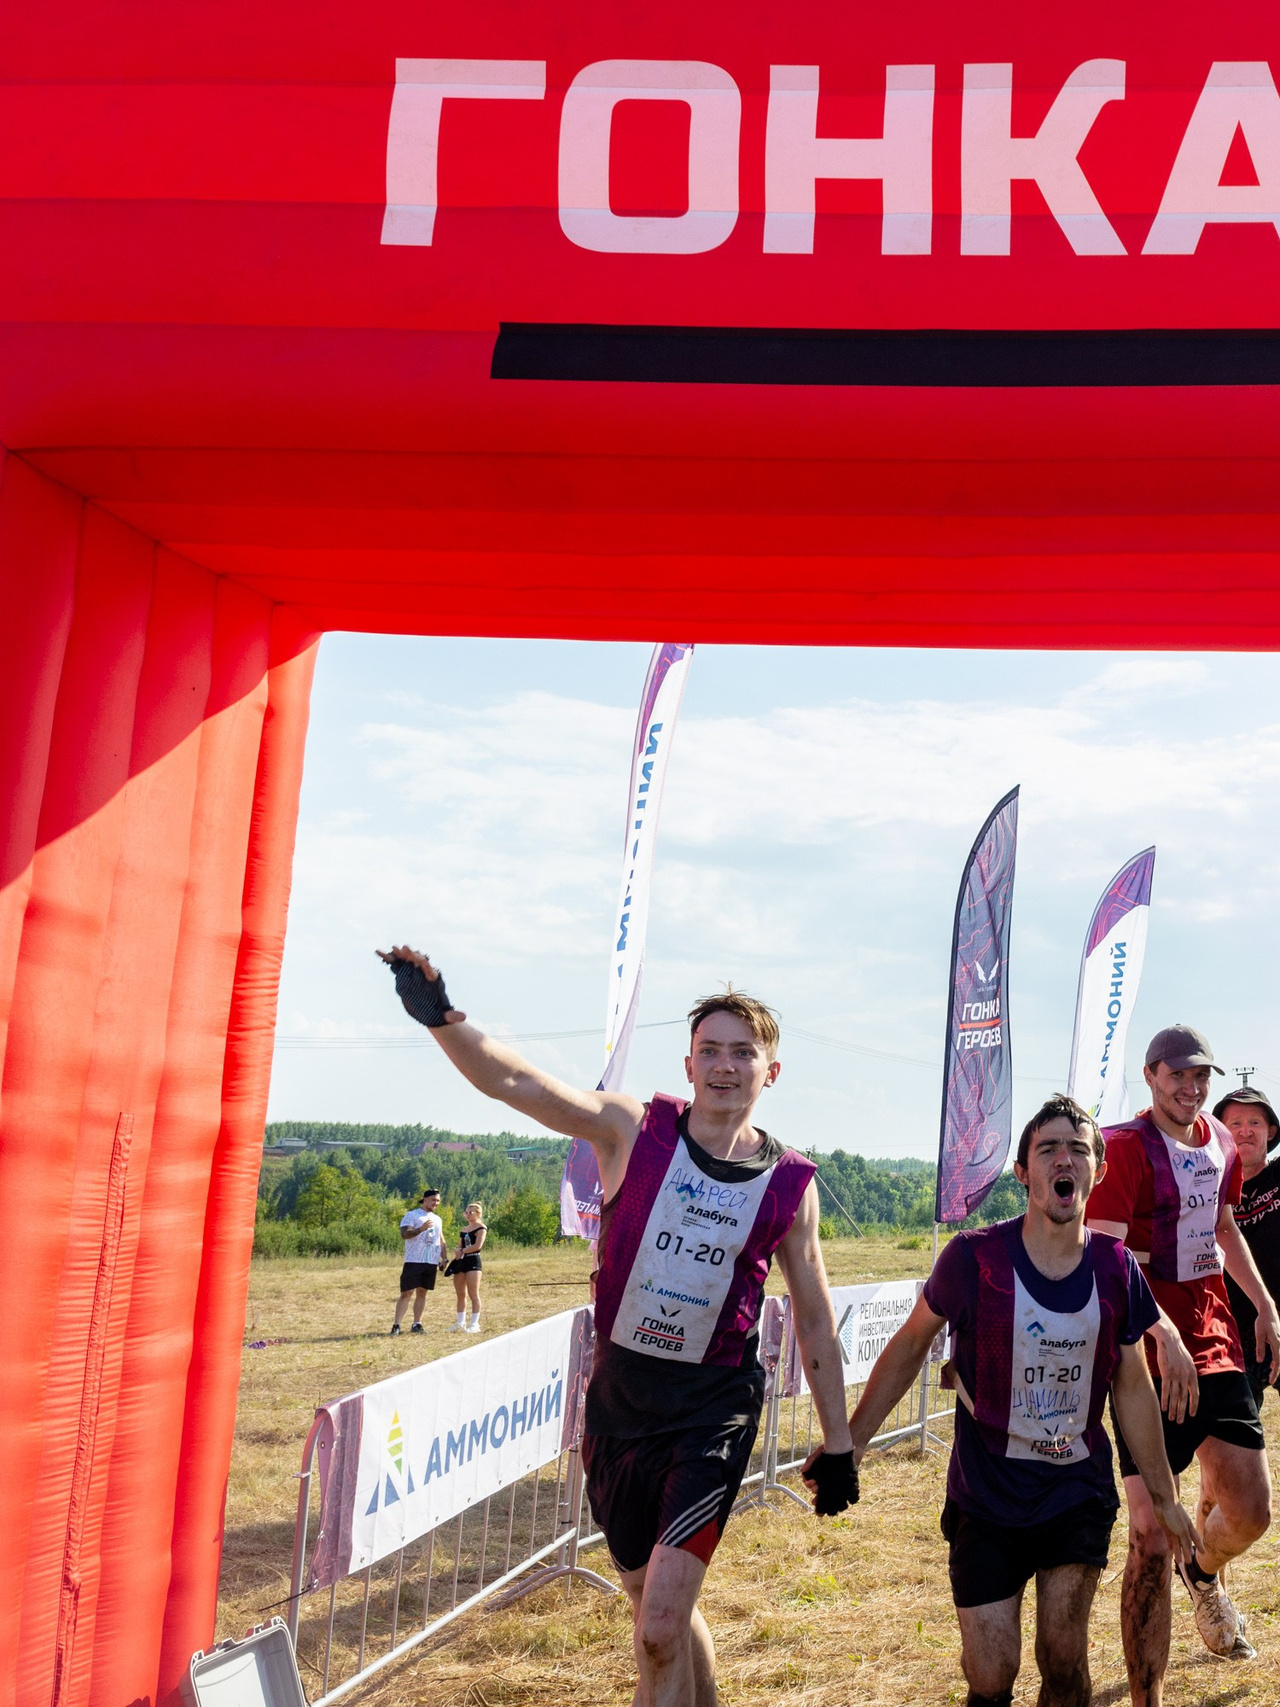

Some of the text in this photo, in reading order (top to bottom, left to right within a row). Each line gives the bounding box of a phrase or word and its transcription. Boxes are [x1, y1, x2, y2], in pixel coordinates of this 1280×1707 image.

[962, 998, 1000, 1021] ГОНКА
[956, 1027, 1002, 1050] ГЕРОЕВ
[1188, 1191, 1218, 1209] 01-2
[686, 1205, 738, 1227] алабуга
[656, 1231, 725, 1266] 01-20
[657, 1288, 710, 1307] АММОНИЙ
[860, 1298, 913, 1320] РЕГИОНАЛЬНАЯ
[642, 1317, 684, 1337] ГОНКА
[859, 1318, 908, 1338] ИНВЕСТИЦИОНН
[633, 1331, 684, 1352] ГЕРОЕВ
[1040, 1338, 1087, 1350] алабуга
[1024, 1365, 1082, 1384] 01-20
[1038, 1407, 1077, 1420] АММОНИЙ
[424, 1368, 563, 1485] АММОНИЙ
[1031, 1446, 1074, 1459] ГЕРОЕВ
[1033, 1437, 1067, 1448] ГОНКА
